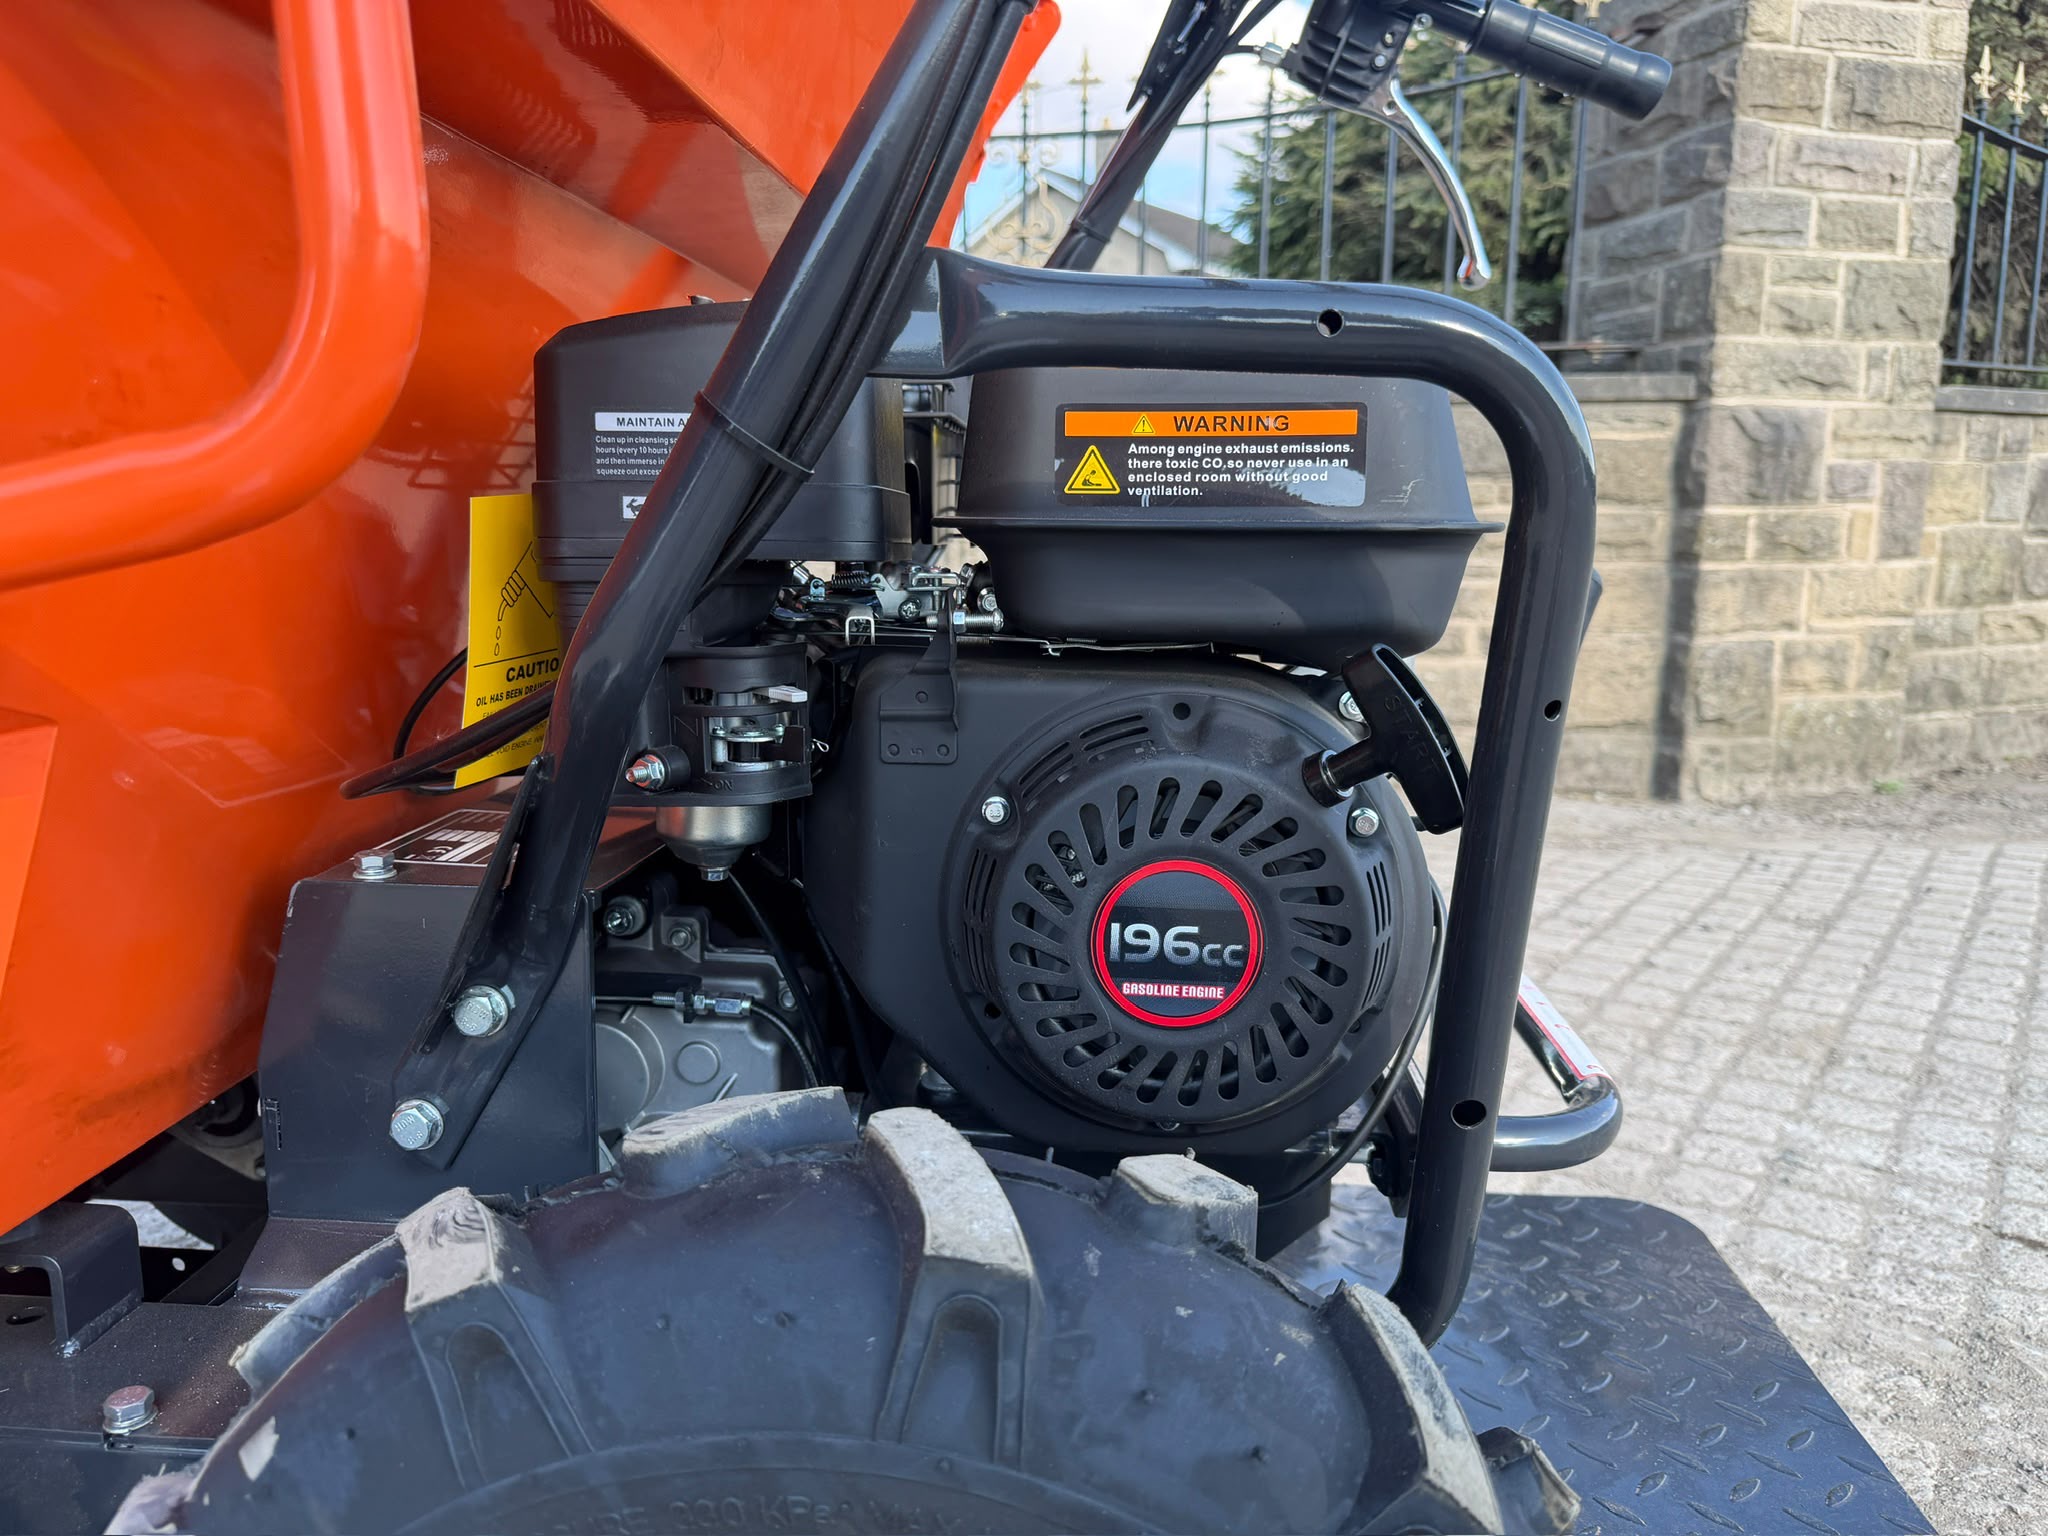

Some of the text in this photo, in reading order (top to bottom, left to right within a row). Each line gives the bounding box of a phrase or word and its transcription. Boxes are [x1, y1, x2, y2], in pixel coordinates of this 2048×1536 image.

[616, 417, 675, 427] MAINTAIN
[1173, 415, 1290, 432] WARNING
[595, 435, 616, 443] Clean
[616, 437, 626, 445] up
[634, 436, 669, 445] cleansing
[595, 446, 616, 454] hours
[616, 446, 638, 456] (every
[639, 446, 647, 454] 10
[648, 446, 668, 454] hours
[1127, 442, 1354, 457] Among engine exhaust emissions.
[610, 457, 626, 465] then
[1127, 458, 1162, 469] there
[1165, 458, 1199, 469] toxic
[1247, 458, 1285, 468] never
[1288, 458, 1313, 468] use
[1316, 457, 1328, 467] in
[1332, 458, 1349, 467] an
[596, 468, 626, 476] squeeze
[1127, 470, 1328, 483] enclosed room without good
[1127, 485, 1203, 496] ventilation.
[475, 697, 488, 707] OIL
[489, 692, 504, 704] HAS
[505, 687, 522, 700] BEEN
[1109, 922, 1244, 968] 196cc
[1122, 982, 1225, 999] GASOLINE ENGINE
